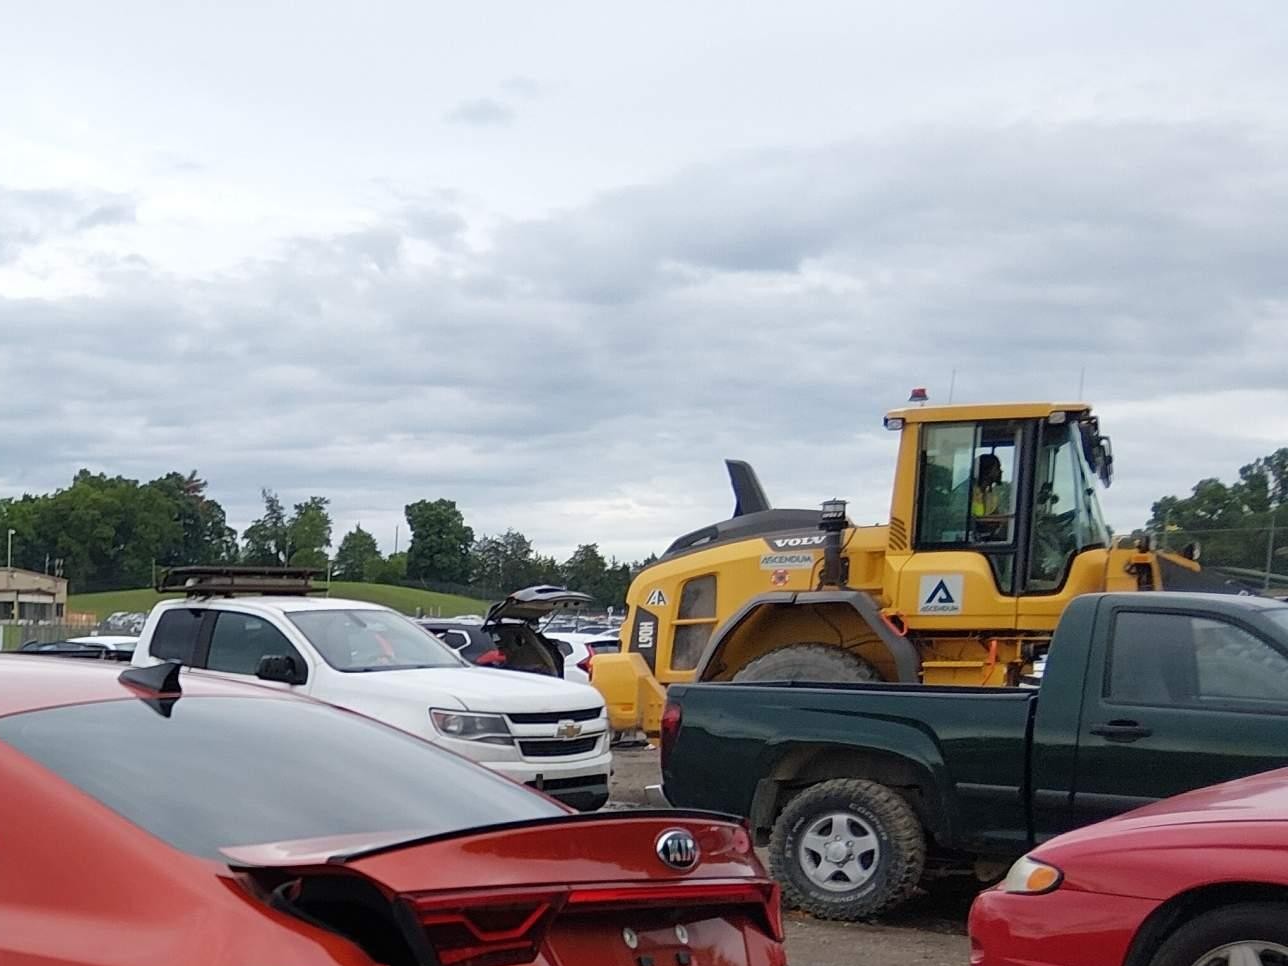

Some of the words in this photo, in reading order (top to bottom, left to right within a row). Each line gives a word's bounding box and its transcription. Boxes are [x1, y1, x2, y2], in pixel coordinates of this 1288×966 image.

[774, 535, 826, 548] VOLV
[761, 554, 812, 565] ASCENDUM
[667, 838, 695, 862] KIA
